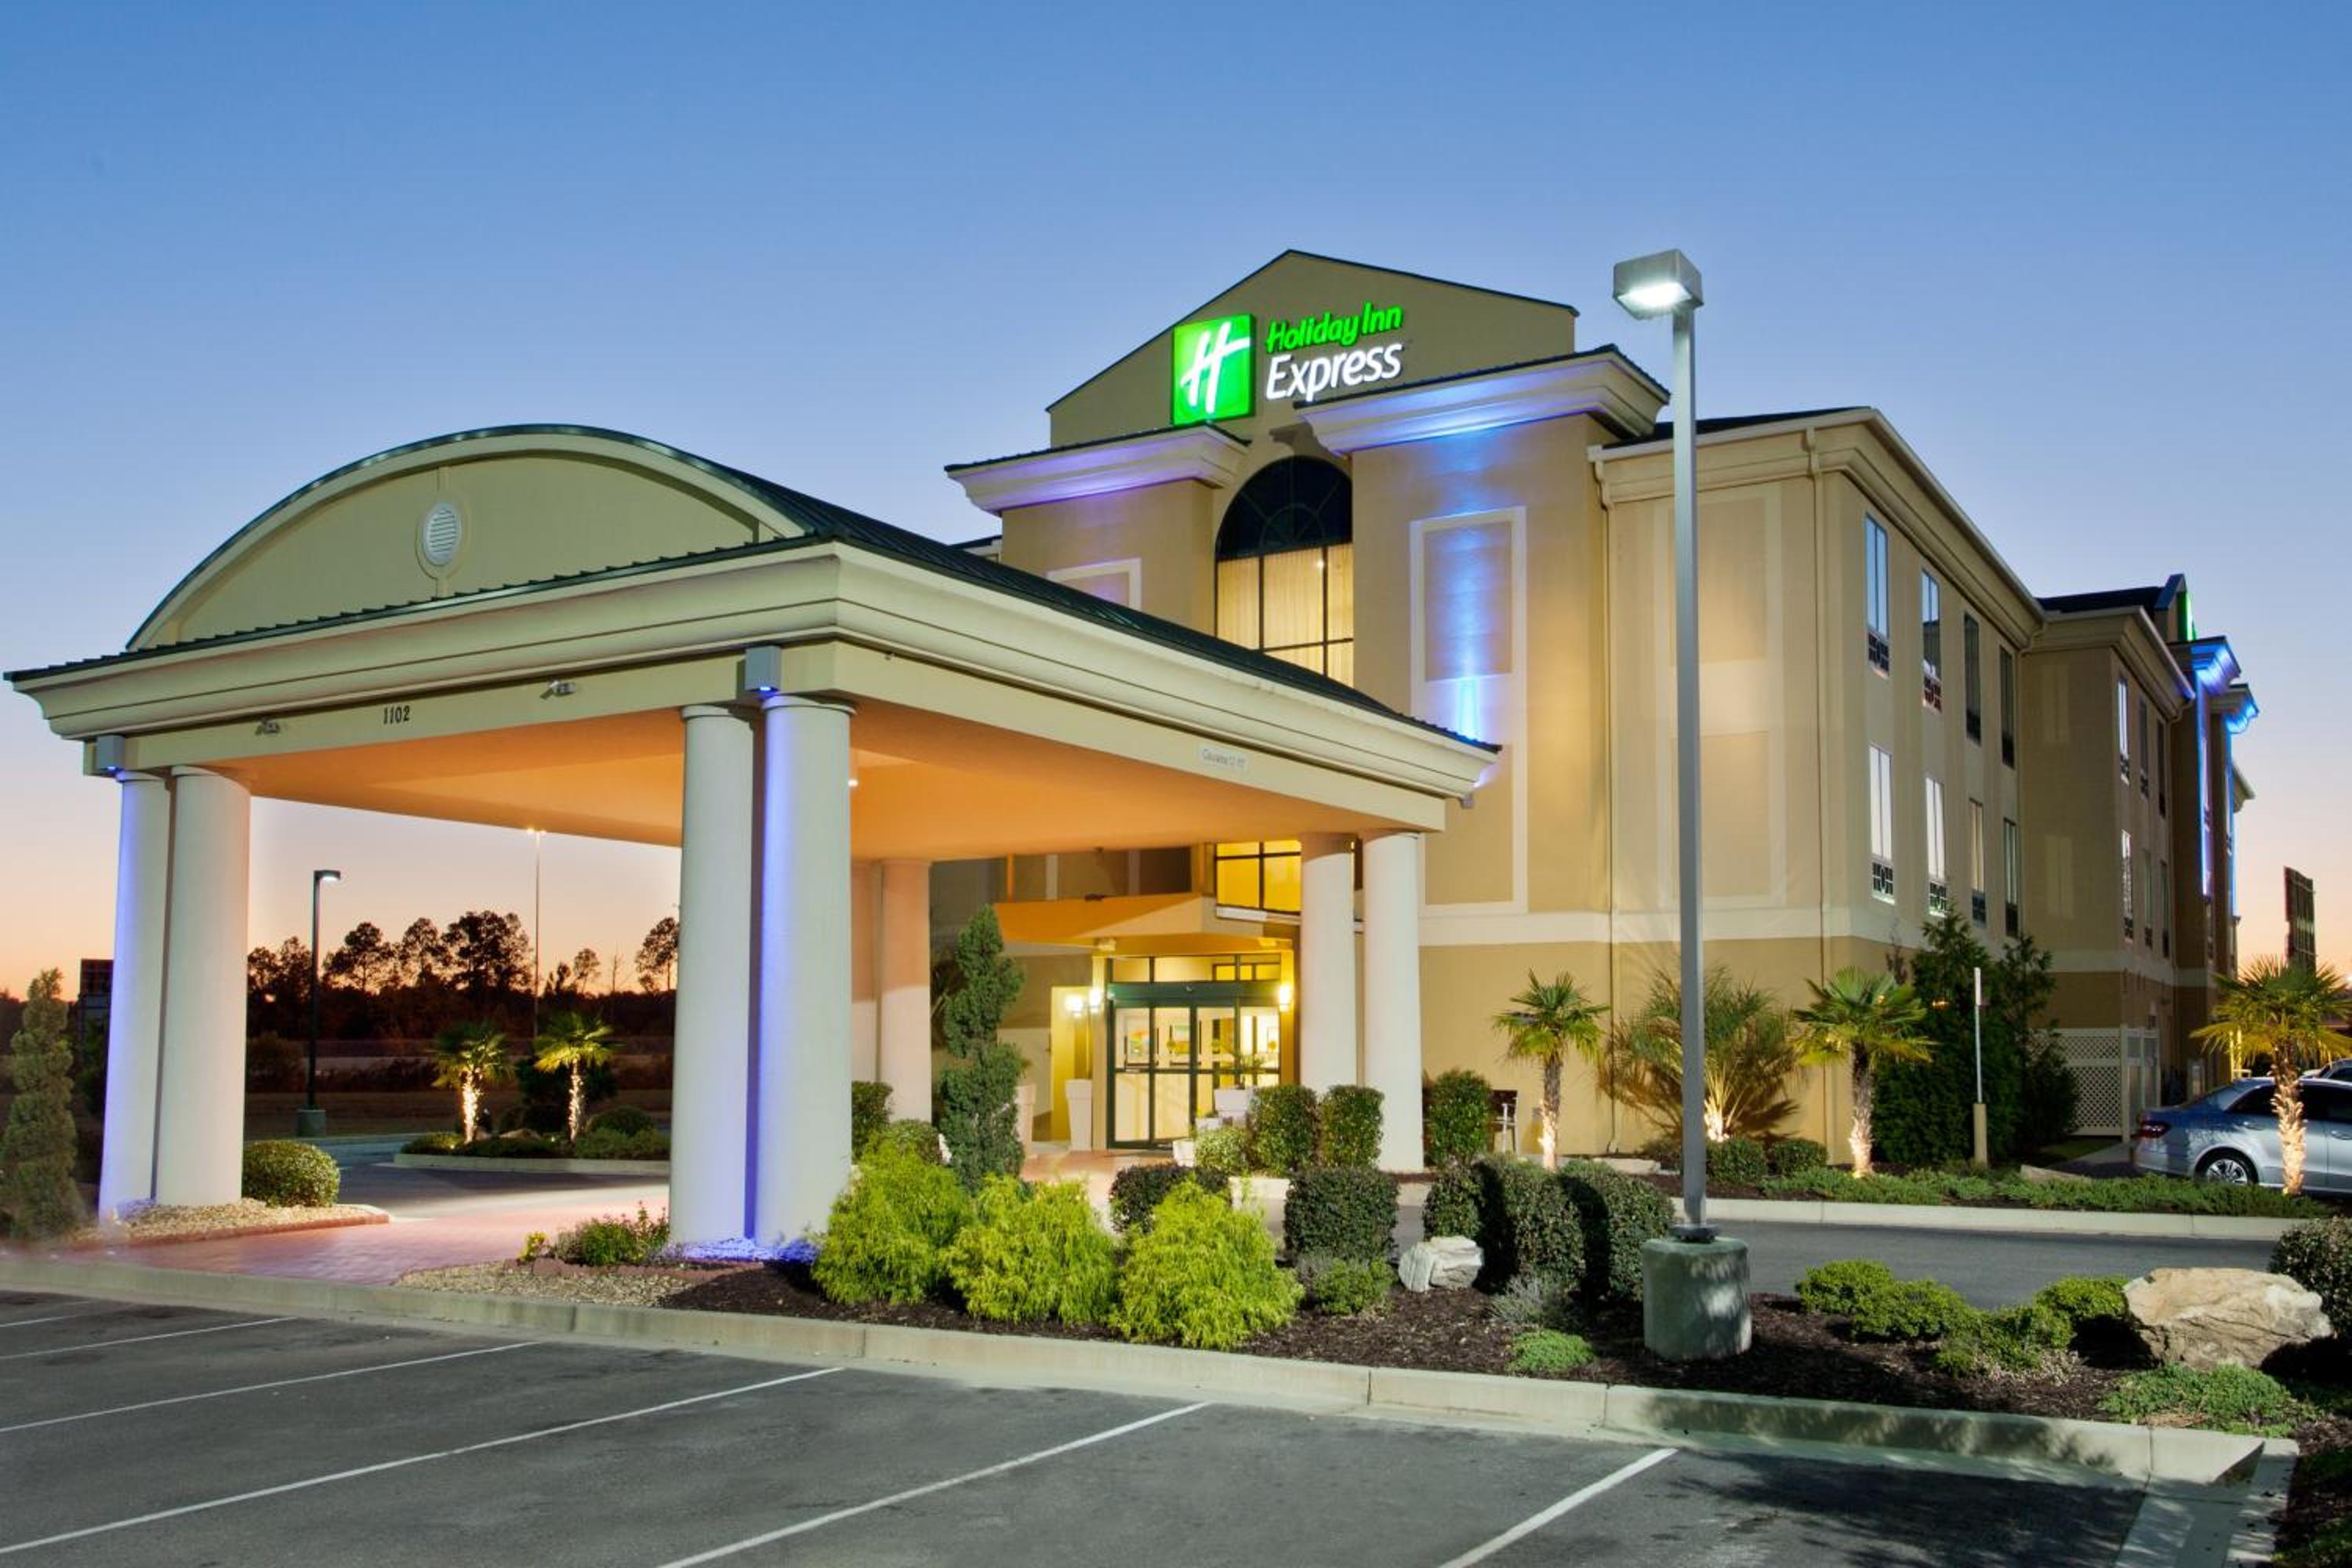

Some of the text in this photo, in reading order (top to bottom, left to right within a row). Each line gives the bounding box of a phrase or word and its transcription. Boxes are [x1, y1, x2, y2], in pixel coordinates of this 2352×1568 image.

[1265, 302, 1403, 353] Holiday Inn
[1265, 343, 1403, 401] Express
[383, 705, 410, 724] 1102
